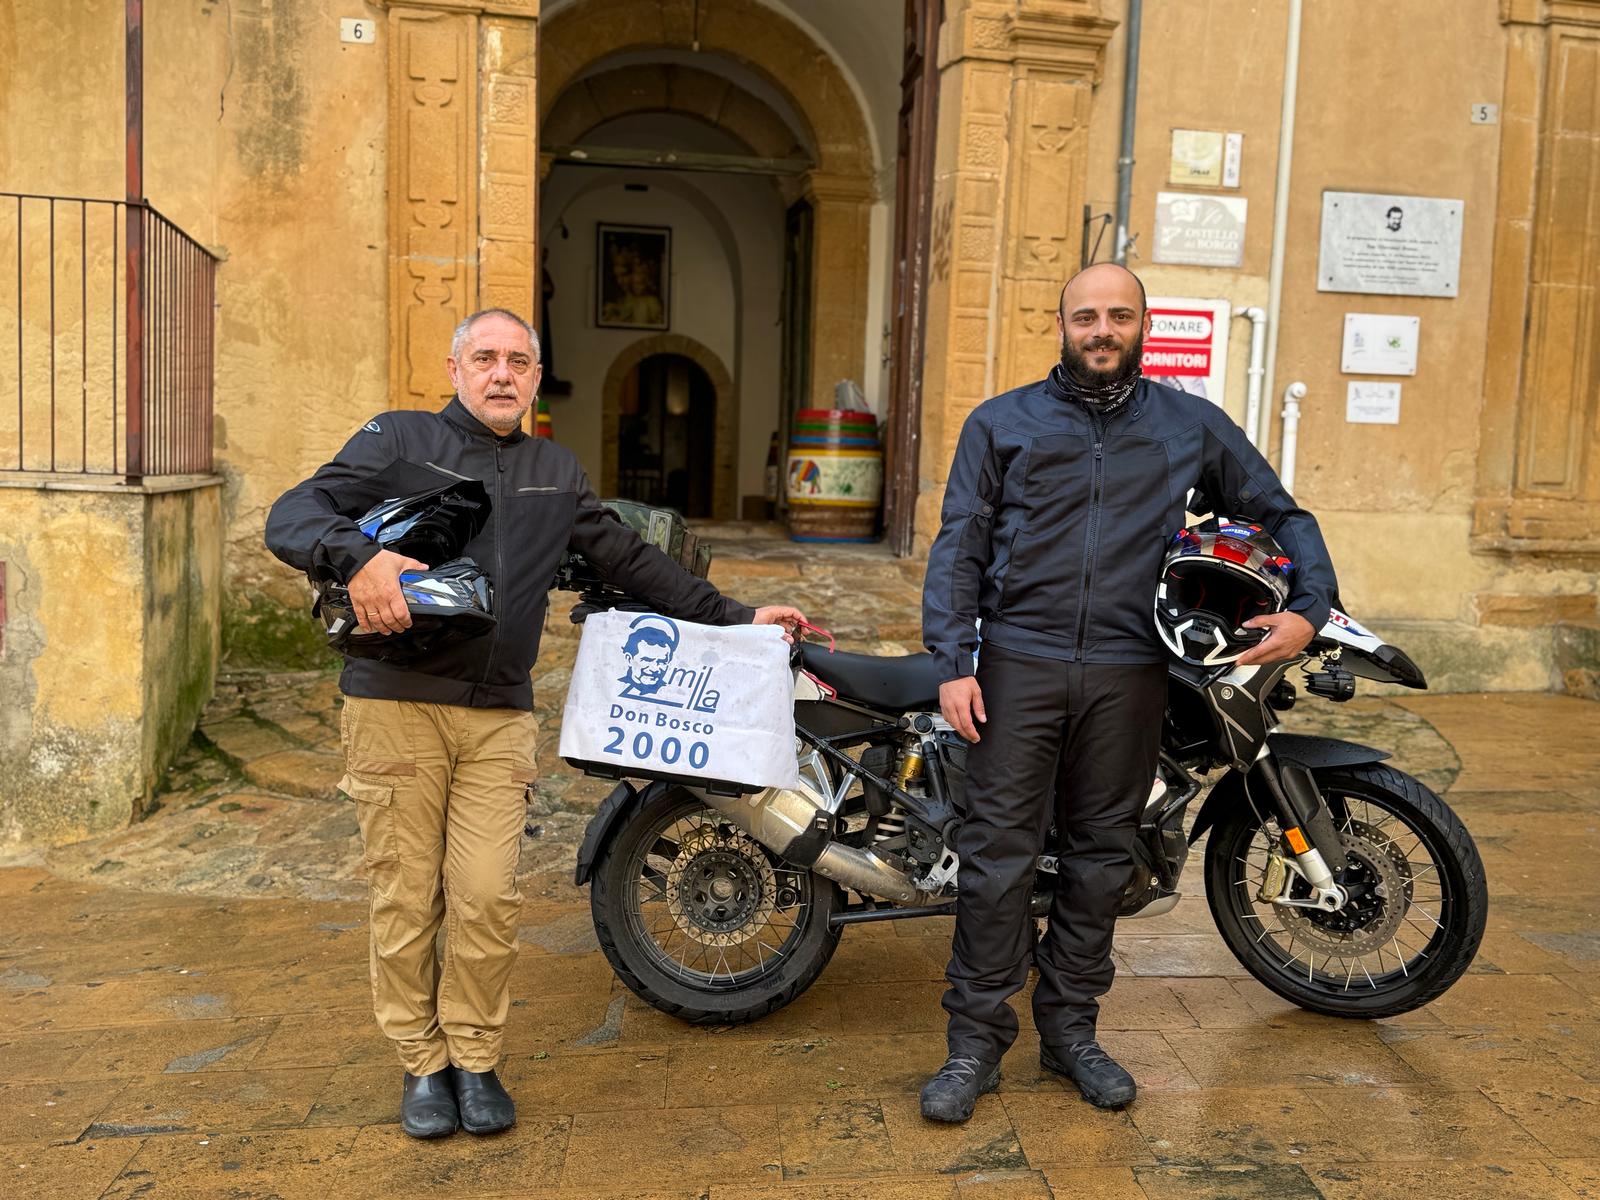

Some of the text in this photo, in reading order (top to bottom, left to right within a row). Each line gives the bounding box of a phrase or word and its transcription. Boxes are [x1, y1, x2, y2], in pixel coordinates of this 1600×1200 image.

[354, 23, 363, 39] 6
[1479, 106, 1488, 121] 5
[1142, 351, 1208, 369] ORNITORI
[609, 703, 714, 735] Don Bosco
[602, 726, 710, 769] 2000
